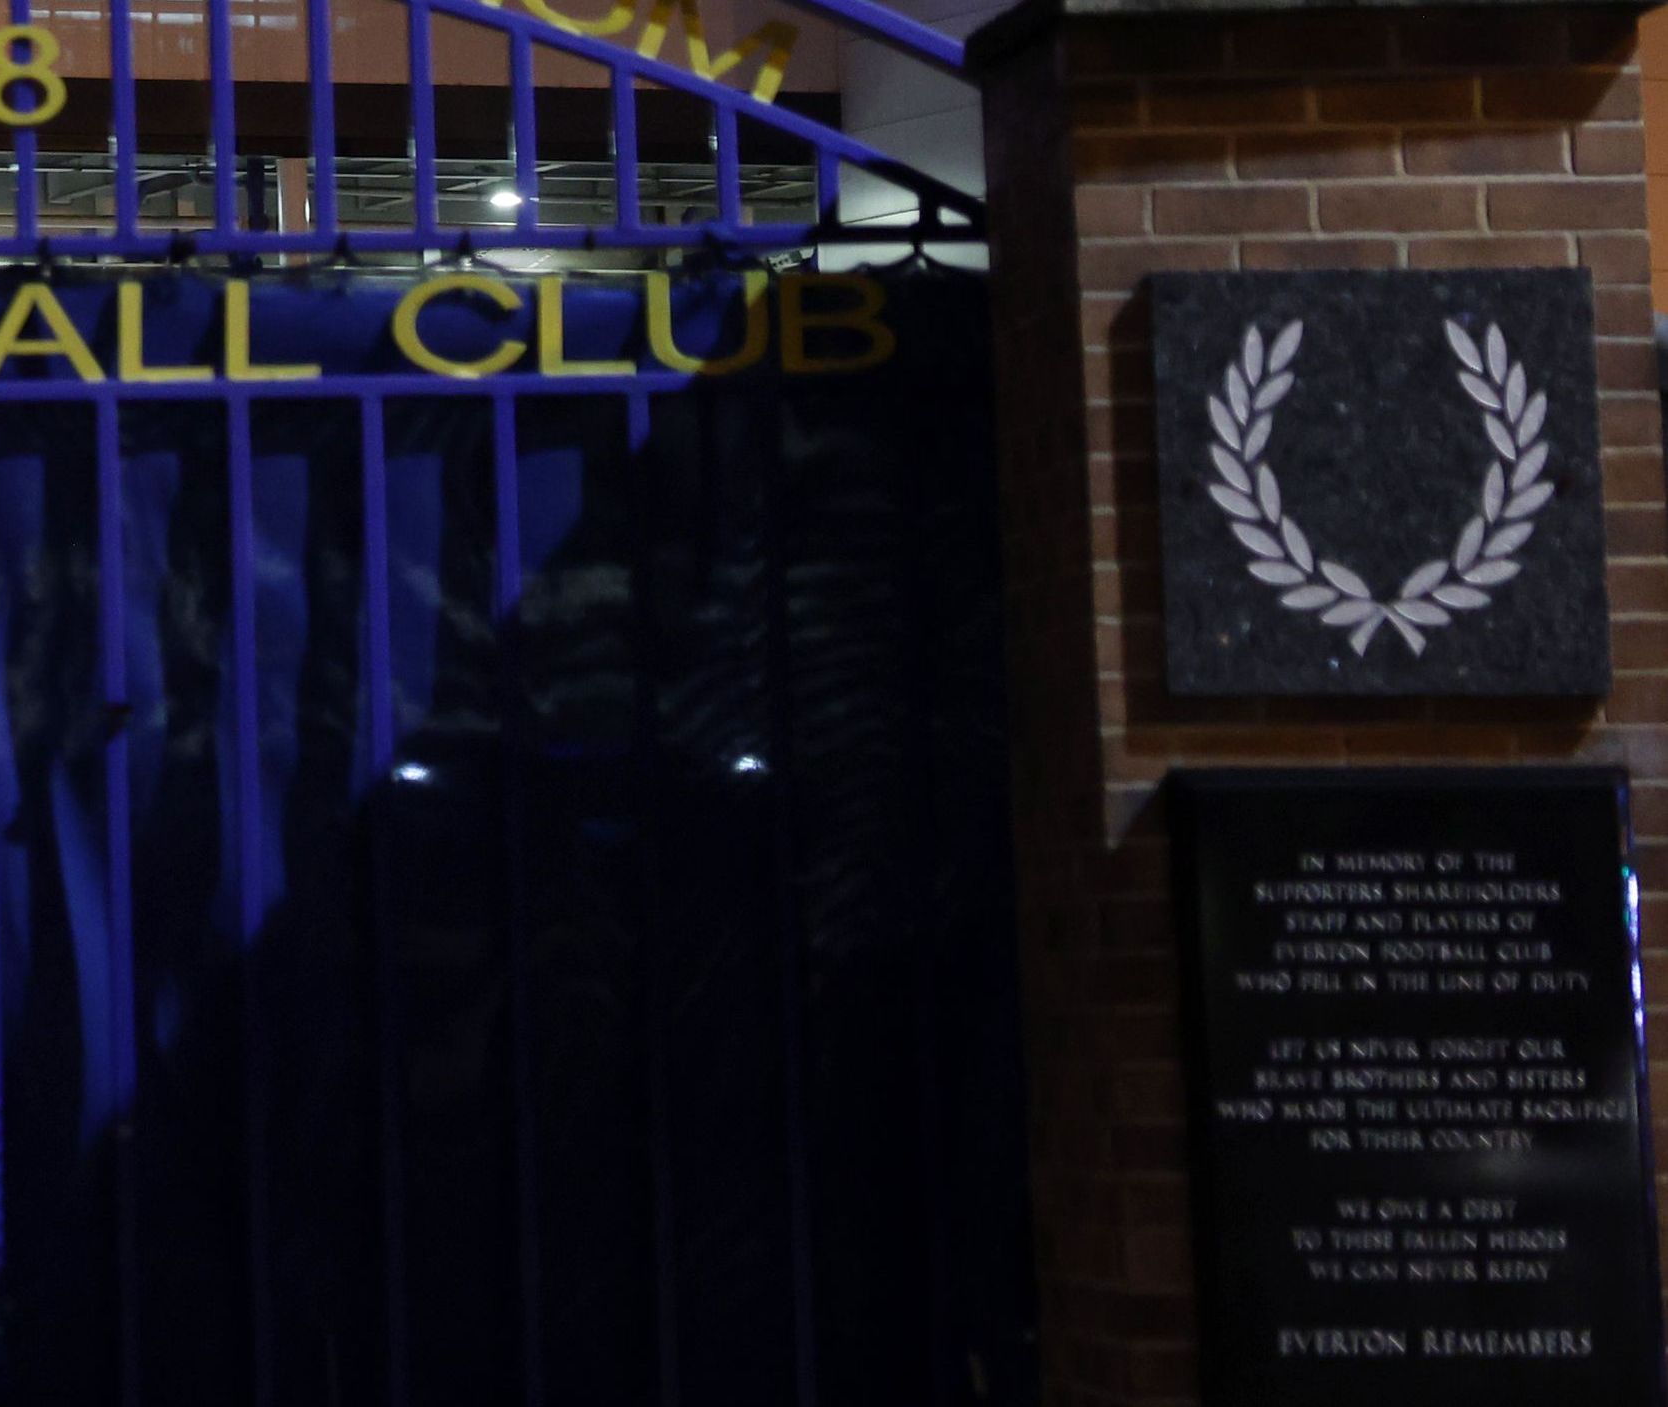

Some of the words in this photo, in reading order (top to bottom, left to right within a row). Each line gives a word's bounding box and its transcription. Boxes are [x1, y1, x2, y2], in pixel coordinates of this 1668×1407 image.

[391, 271, 899, 379] CLUB
[1299, 852, 1325, 871] IN
[1337, 852, 1425, 871] MEMORY
[1435, 852, 1464, 871] OF
[1475, 852, 1515, 871] THE
[1254, 882, 1383, 902] SUPPORTERS
[1393, 882, 1560, 902] SHAREHOLDERS
[1285, 912, 1347, 932] STAFF
[1354, 912, 1402, 932] AND
[1411, 912, 1499, 932] PLAYERS
[1507, 912, 1535, 932] OF
[1273, 942, 1370, 961] EVERTON
[1379, 942, 1486, 961] FOOTBALL
[1496, 942, 1552, 961] CLUB
[1235, 973, 1290, 992] WHO
[1299, 973, 1341, 992] FELL
[1353, 973, 1377, 992] IN
[1388, 973, 1429, 992] THE
[1438, 973, 1484, 992] LINE
[1493, 973, 1521, 992] OF
[1531, 973, 1589, 992] DUTY
[1269, 1039, 1306, 1060] LET
[1314, 1039, 1341, 1060] US
[1350, 1039, 1419, 1060] NEVER
[1429, 1039, 1509, 1060] FORGET
[1517, 1039, 1564, 1060] OUR
[1217, 1099, 1273, 1120] WHO
[1282, 1099, 1346, 1120] MADE
[1356, 1099, 1396, 1120] THE
[1406, 1099, 1512, 1120] ULTIMATE
[1522, 1099, 1626, 1120] SACRIFICE
[1310, 1130, 1351, 1151] FOR
[1359, 1130, 1424, 1151] THEIR
[1432, 1130, 1533, 1151] COUNTRY
[1337, 1198, 1370, 1219] WE
[1378, 1198, 1427, 1219] OWE
[1438, 1198, 1452, 1219] A
[1462, 1198, 1516, 1219] DEBT
[1292, 1229, 1321, 1250] TO
[1330, 1229, 1393, 1250] THESE
[1403, 1229, 1477, 1250] FALLEN
[1488, 1229, 1567, 1250] HEROES
[1308, 1261, 1342, 1281] WE
[1351, 1261, 1398, 1281] CAN
[1408, 1261, 1477, 1281] NEVER
[1487, 1261, 1550, 1281] REPAY
[1279, 1329, 1406, 1356] EVERTON
[1422, 1329, 1592, 1356] REMEMBERS
